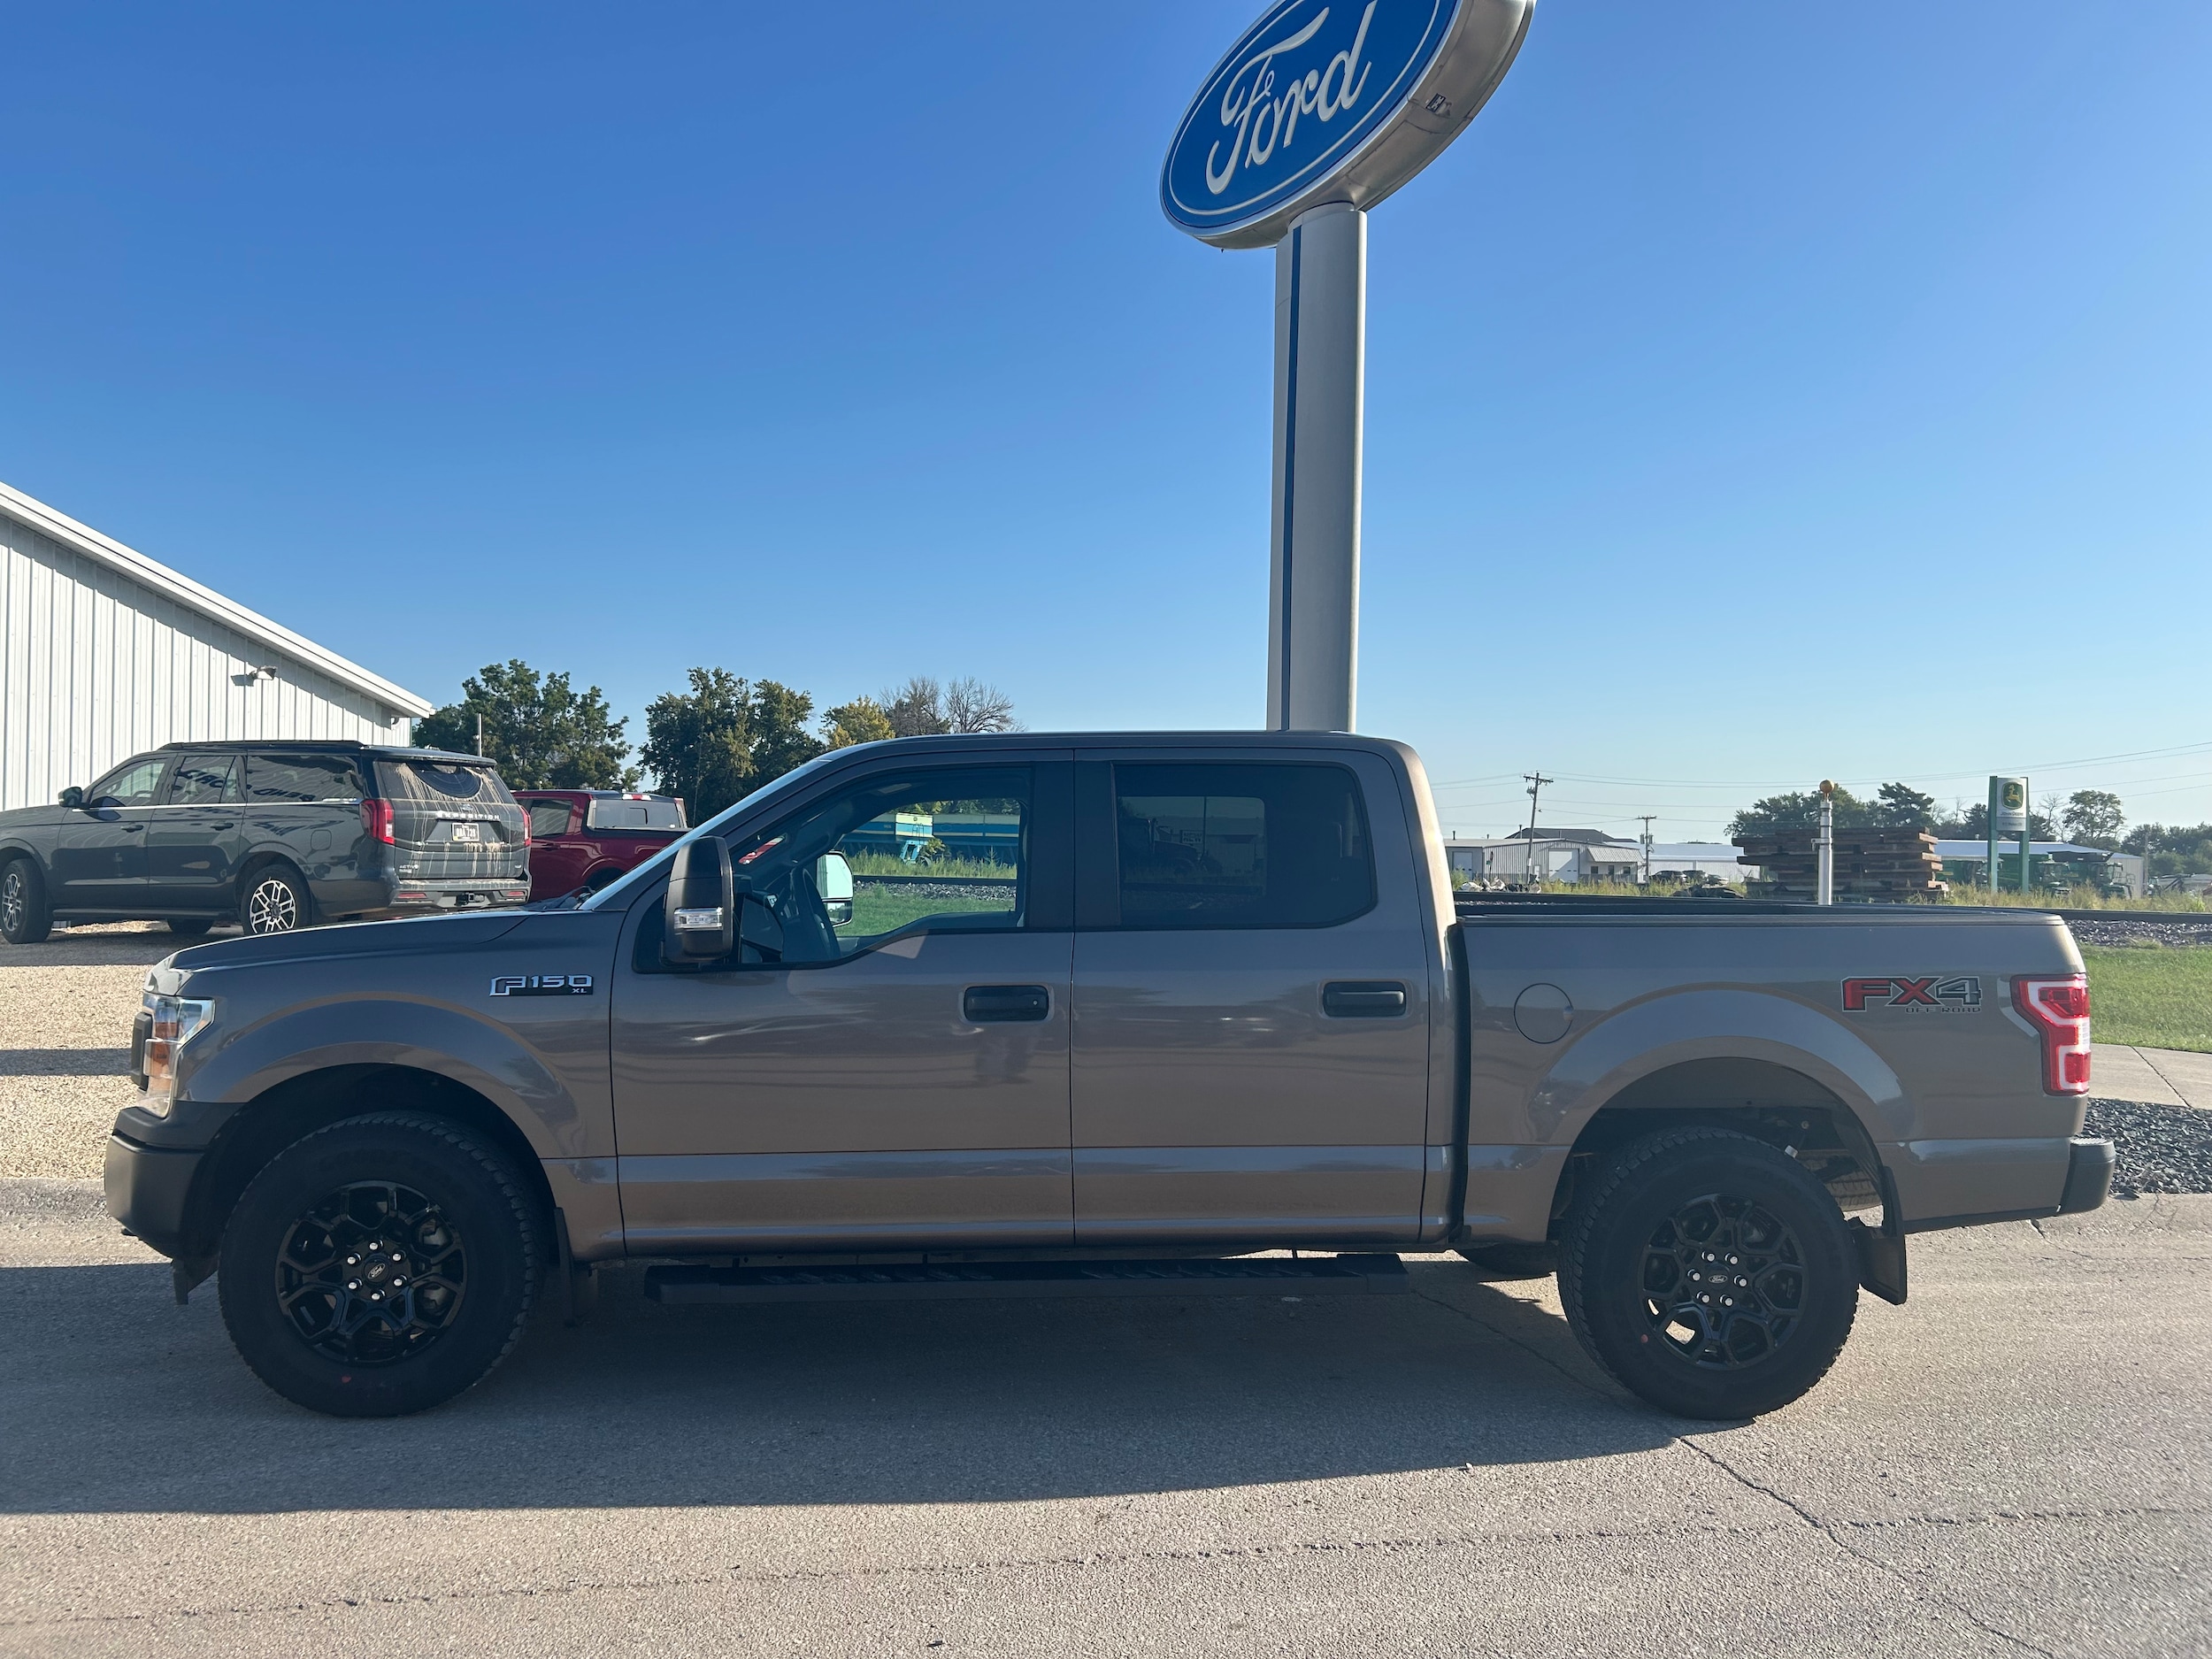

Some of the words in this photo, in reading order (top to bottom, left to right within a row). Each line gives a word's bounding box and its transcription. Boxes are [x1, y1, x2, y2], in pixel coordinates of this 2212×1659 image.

[1205, 0, 1377, 195] Ford
[1841, 976, 1982, 1012] FX4
[369, 1264, 384, 1277] Ford
